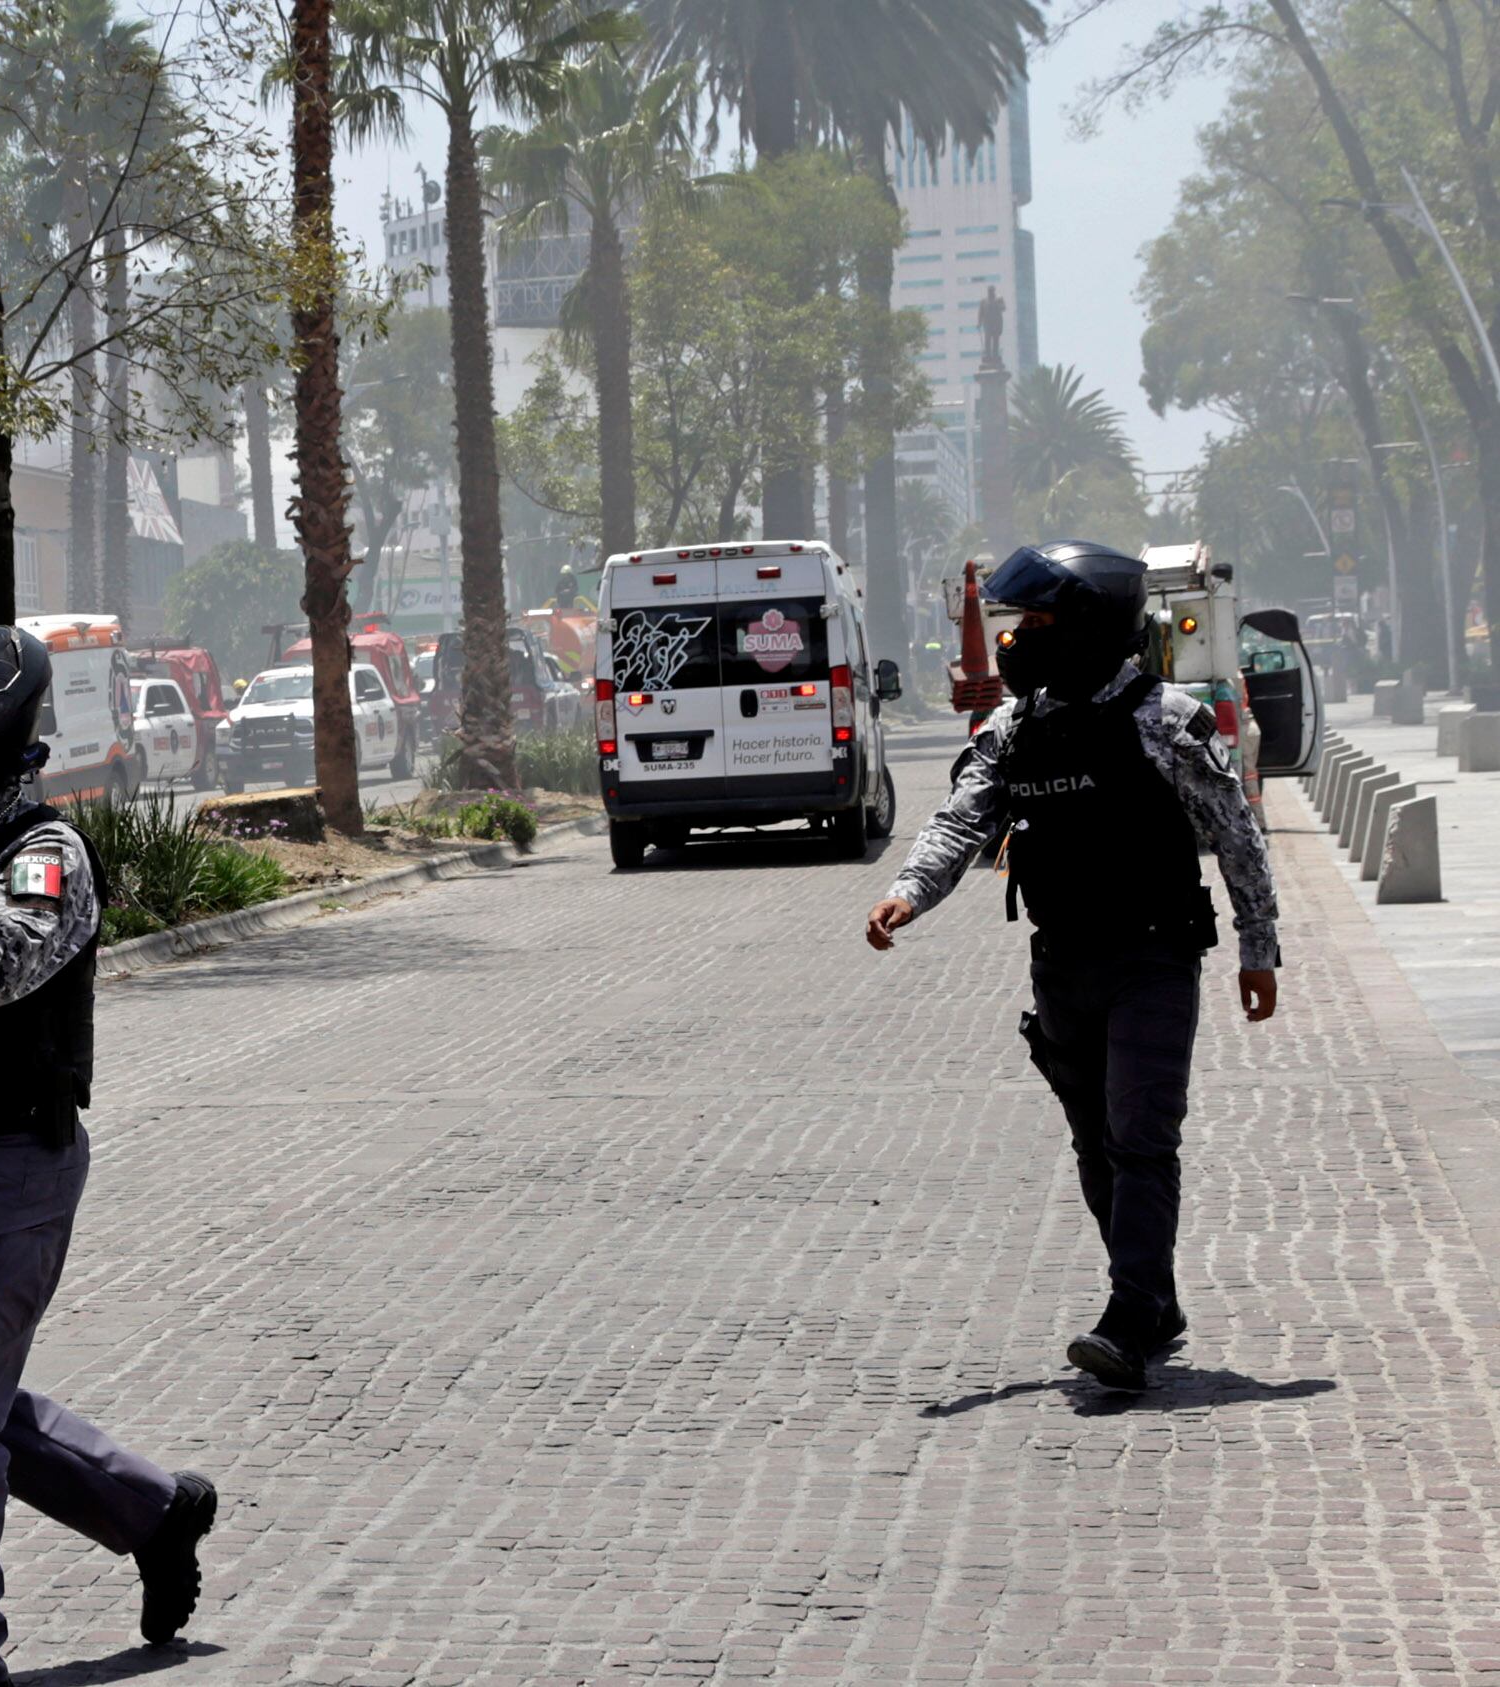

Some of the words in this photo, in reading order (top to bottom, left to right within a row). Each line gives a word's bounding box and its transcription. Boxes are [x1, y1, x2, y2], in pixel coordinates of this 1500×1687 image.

[744, 633, 803, 652] SUMA
[733, 738, 772, 751] Hacer
[773, 734, 825, 748] historia.
[733, 752, 772, 765] Hacer
[773, 751, 815, 765] futuro.
[643, 761, 695, 772] SUMA-235
[1009, 775, 1096, 797] POLICIA
[14, 855, 60, 865] MEXICO
